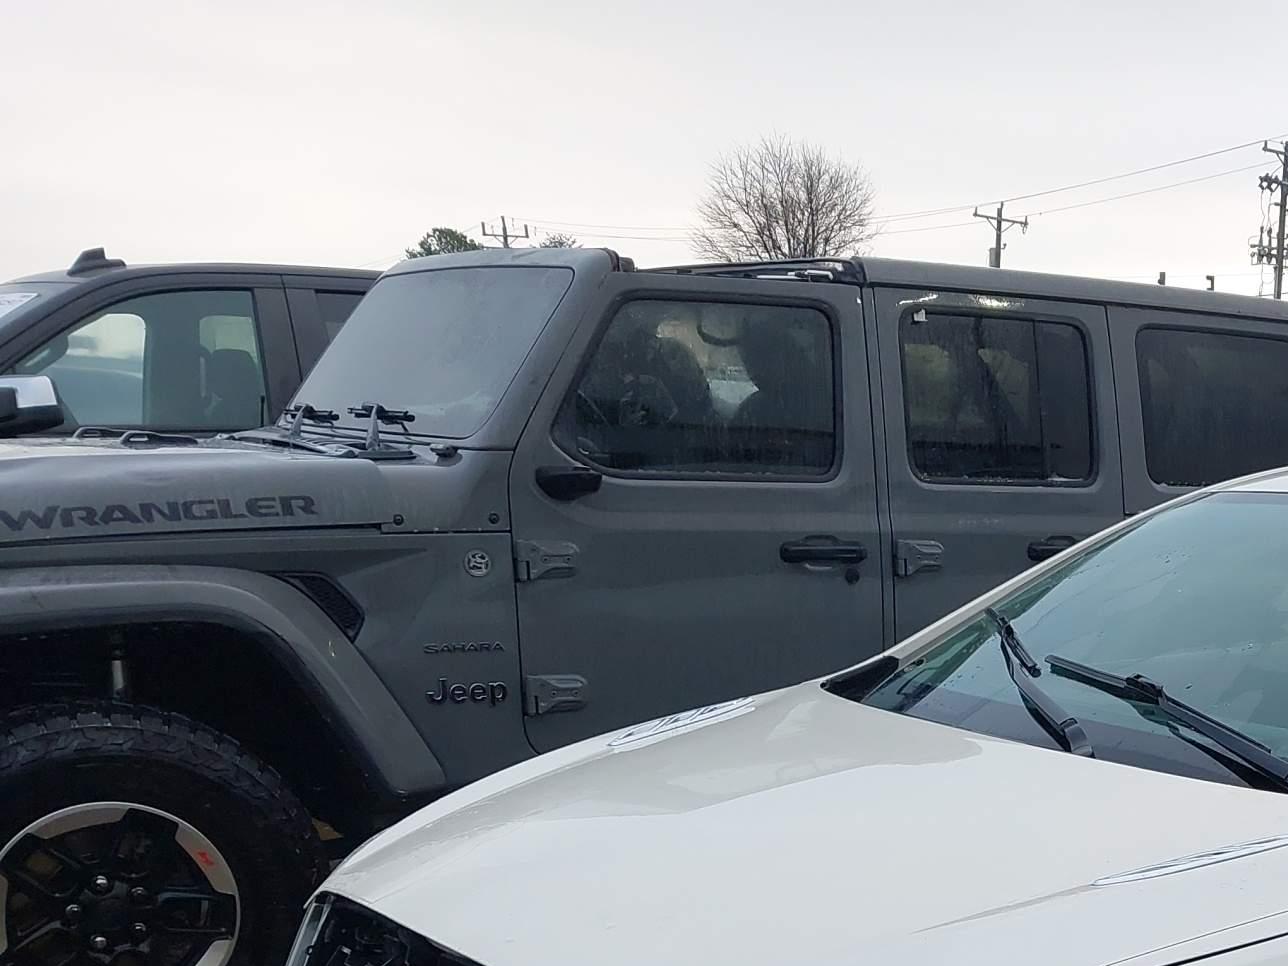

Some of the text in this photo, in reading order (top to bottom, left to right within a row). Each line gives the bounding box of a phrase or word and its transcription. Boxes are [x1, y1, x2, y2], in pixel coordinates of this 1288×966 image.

[0, 495, 319, 532] WRANGLER
[423, 641, 505, 654] SAHARA
[425, 677, 509, 708] Jeep
